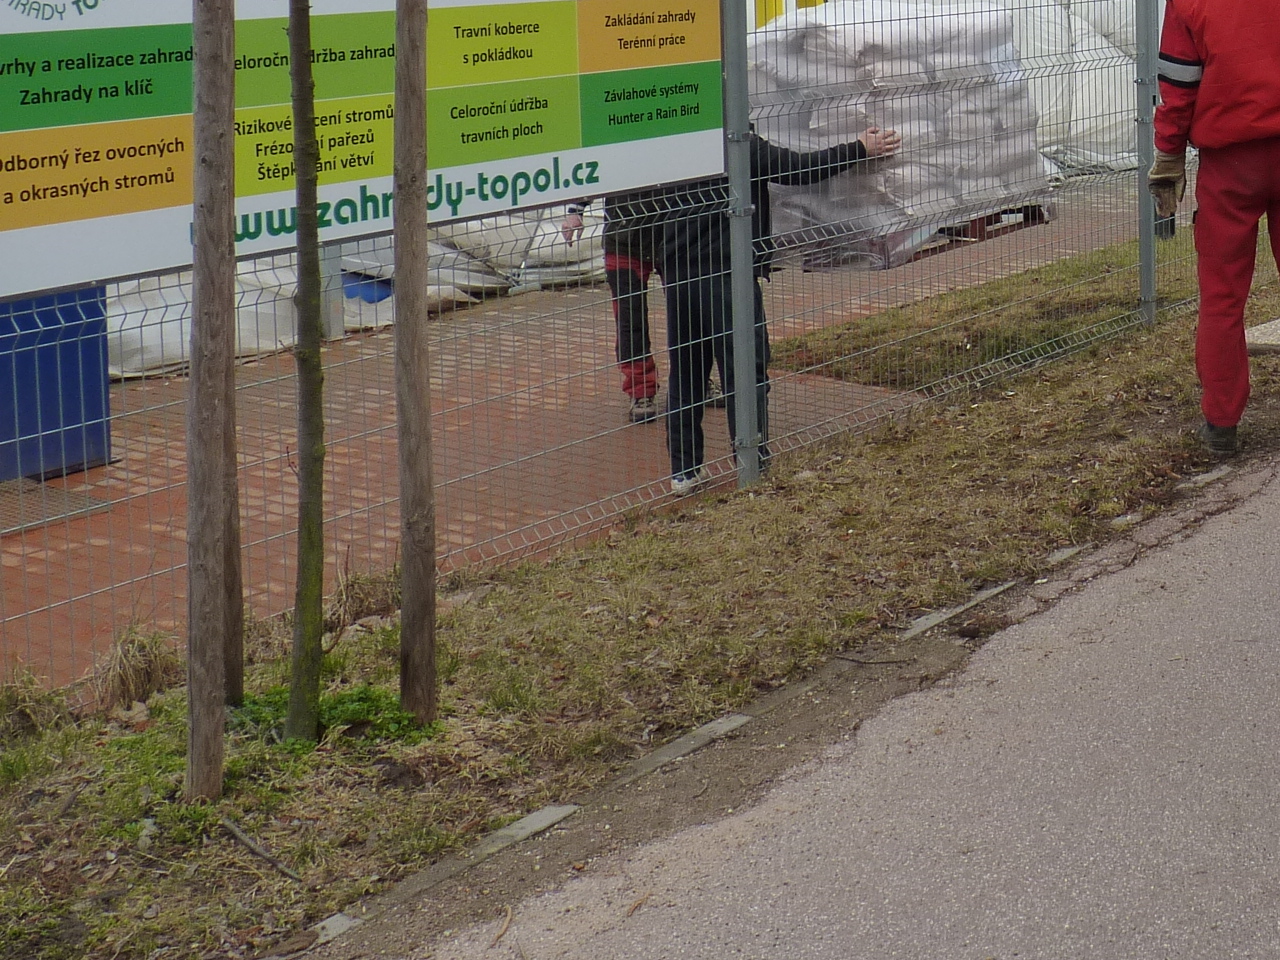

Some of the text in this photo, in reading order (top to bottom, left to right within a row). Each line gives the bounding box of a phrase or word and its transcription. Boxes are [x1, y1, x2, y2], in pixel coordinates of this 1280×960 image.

[453, 21, 540, 39] Travní koberce
[605, 9, 696, 28] Zakládání zahrady
[617, 33, 686, 50] Terénní práce
[41, 59, 52, 72] a
[57, 52, 135, 72] realizace
[139, 45, 194, 66] zahrad
[234, 43, 396, 70] eloročn držba zahrad
[462, 46, 533, 66] s pokládkou
[19, 77, 154, 105] Zahrady na klíč
[604, 81, 699, 103] Závlahové systémy
[233, 104, 394, 137] Rizikové cení stromů
[450, 96, 549, 120] Celoroční údržba
[608, 102, 700, 126] Hunter a Rain Bird
[255, 128, 375, 158] Frézoí pařezů
[460, 121, 544, 144] travních ploch
[0, 136, 185, 173] dborný řez ovocných
[257, 150, 375, 180] Štěpkání větví
[3, 166, 175, 205] a okrasných stromů
